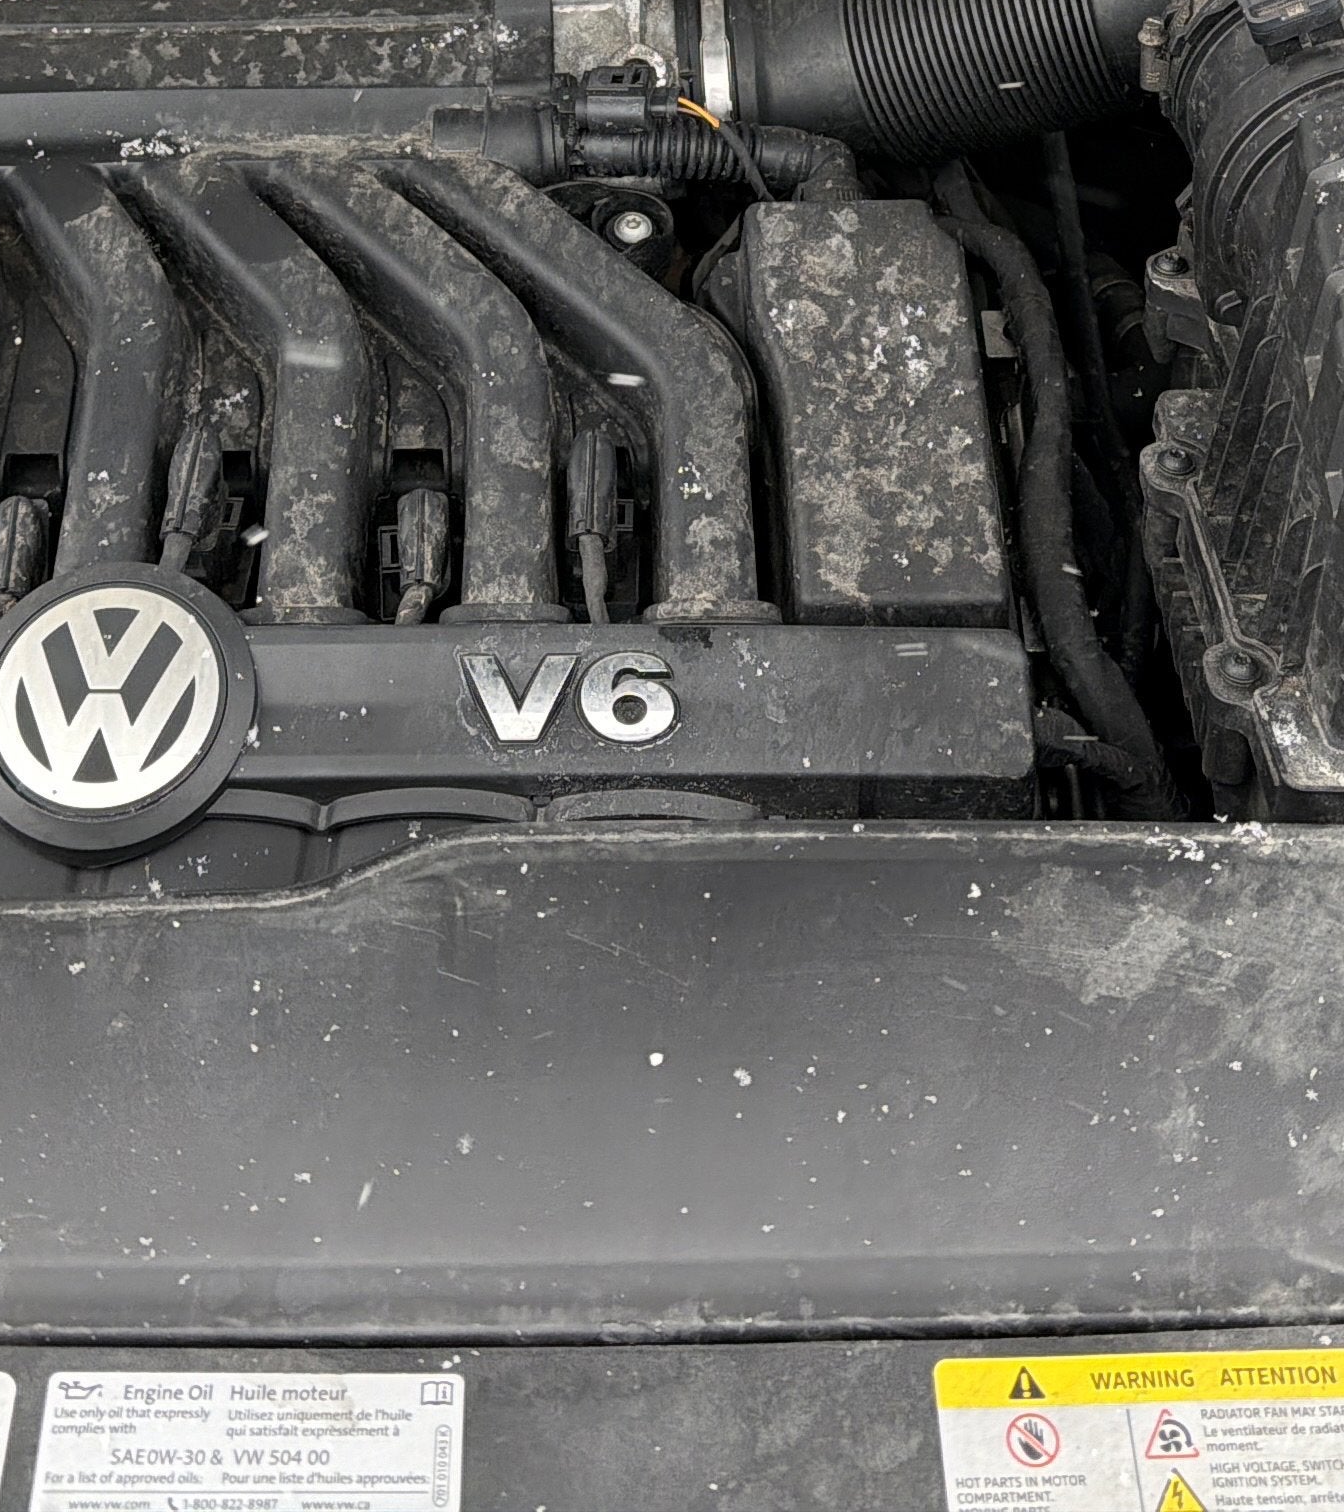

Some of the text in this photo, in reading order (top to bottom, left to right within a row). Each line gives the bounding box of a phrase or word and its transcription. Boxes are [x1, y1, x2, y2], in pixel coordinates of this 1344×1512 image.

[456, 650, 682, 746] V6
[1090, 1366, 1337, 1389] WARNING ATTENTION
[123, 1384, 214, 1405] Engine Oil
[230, 1385, 348, 1402] Huile moteur
[54, 1408, 211, 1424] Use only oil that expressly
[228, 1409, 413, 1425] Utilisez uniquement de l'huile
[1200, 1407, 1261, 1419] RADIATOR
[1264, 1407, 1288, 1417] FAN
[1291, 1406, 1317, 1418] MAY
[51, 1422, 137, 1437] complies with
[226, 1424, 247, 1440] qui
[249, 1424, 299, 1438] satisfait
[392, 1424, 401, 1438] à
[1203, 1425, 1218, 1437] Le
[1221, 1424, 1287, 1437] ventilateur
[1290, 1424, 1306, 1435] de
[1206, 1441, 1263, 1452] moment.
[110, 1448, 330, 1466] SAE0W-30 & VW 504 00
[437, 1461, 448, 1481] 010
[1210, 1463, 1240, 1474] HIGH
[44, 1472, 64, 1484] For
[66, 1475, 75, 1484] a
[78, 1472, 96, 1484] list
[99, 1471, 113, 1484] of
[115, 1472, 175, 1488] approved
[222, 1472, 250, 1485] Pour
[252, 1475, 276, 1485] une
[278, 1471, 304, 1485] liste
[306, 1471, 353, 1485] d'huiles
[956, 1475, 1087, 1489] HOT PARTS IN MOTOR
[1212, 1474, 1323, 1488] IGNITION SYSTEM.
[68, 1499, 151, 1510] www.vw.com
[182, 1498, 278, 1511] 1-800-822-8987
[301, 1500, 371, 1511] www.vw.ca
[1215, 1495, 1254, 1506] Haute
